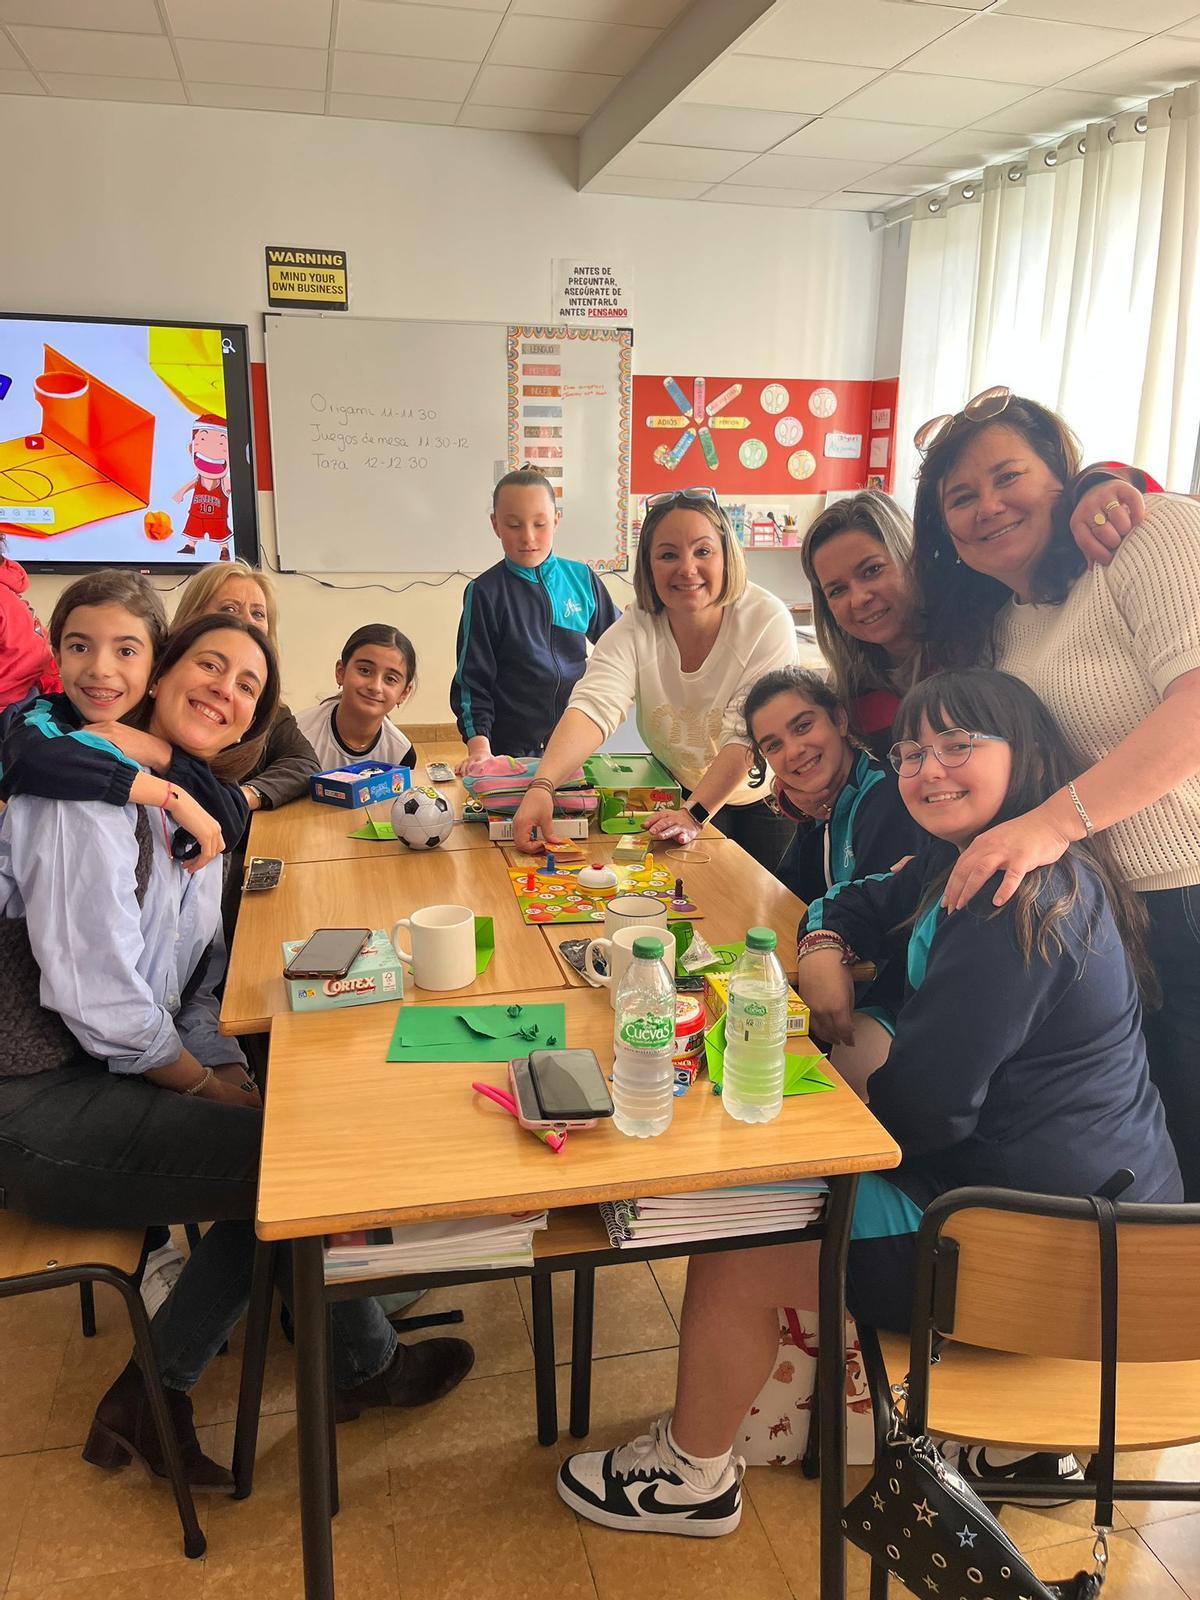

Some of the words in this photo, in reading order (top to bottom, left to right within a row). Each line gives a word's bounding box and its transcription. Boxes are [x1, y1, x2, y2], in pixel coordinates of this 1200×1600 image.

[268, 251, 343, 266] WARNING
[280, 271, 306, 282] MIND
[308, 273, 336, 284] YOUR
[573, 267, 600, 275] ANTES
[601, 267, 612, 275] DE
[272, 282, 295, 292] OWN
[297, 283, 344, 295] BUSINESS
[568, 277, 618, 287] PREGUNTAR,
[564, 286, 610, 296] ASEGÚRATE
[612, 287, 622, 296] DE
[568, 298, 618, 306] INTENTARLO
[559, 308, 586, 317] ANTES
[587, 308, 628, 318] PENSANDO
[310, 393, 375, 426] Origami
[310, 424, 359, 452] Juegos
[200, 502, 215, 515] 10
[1057, 1452, 1078, 1476] NIK
